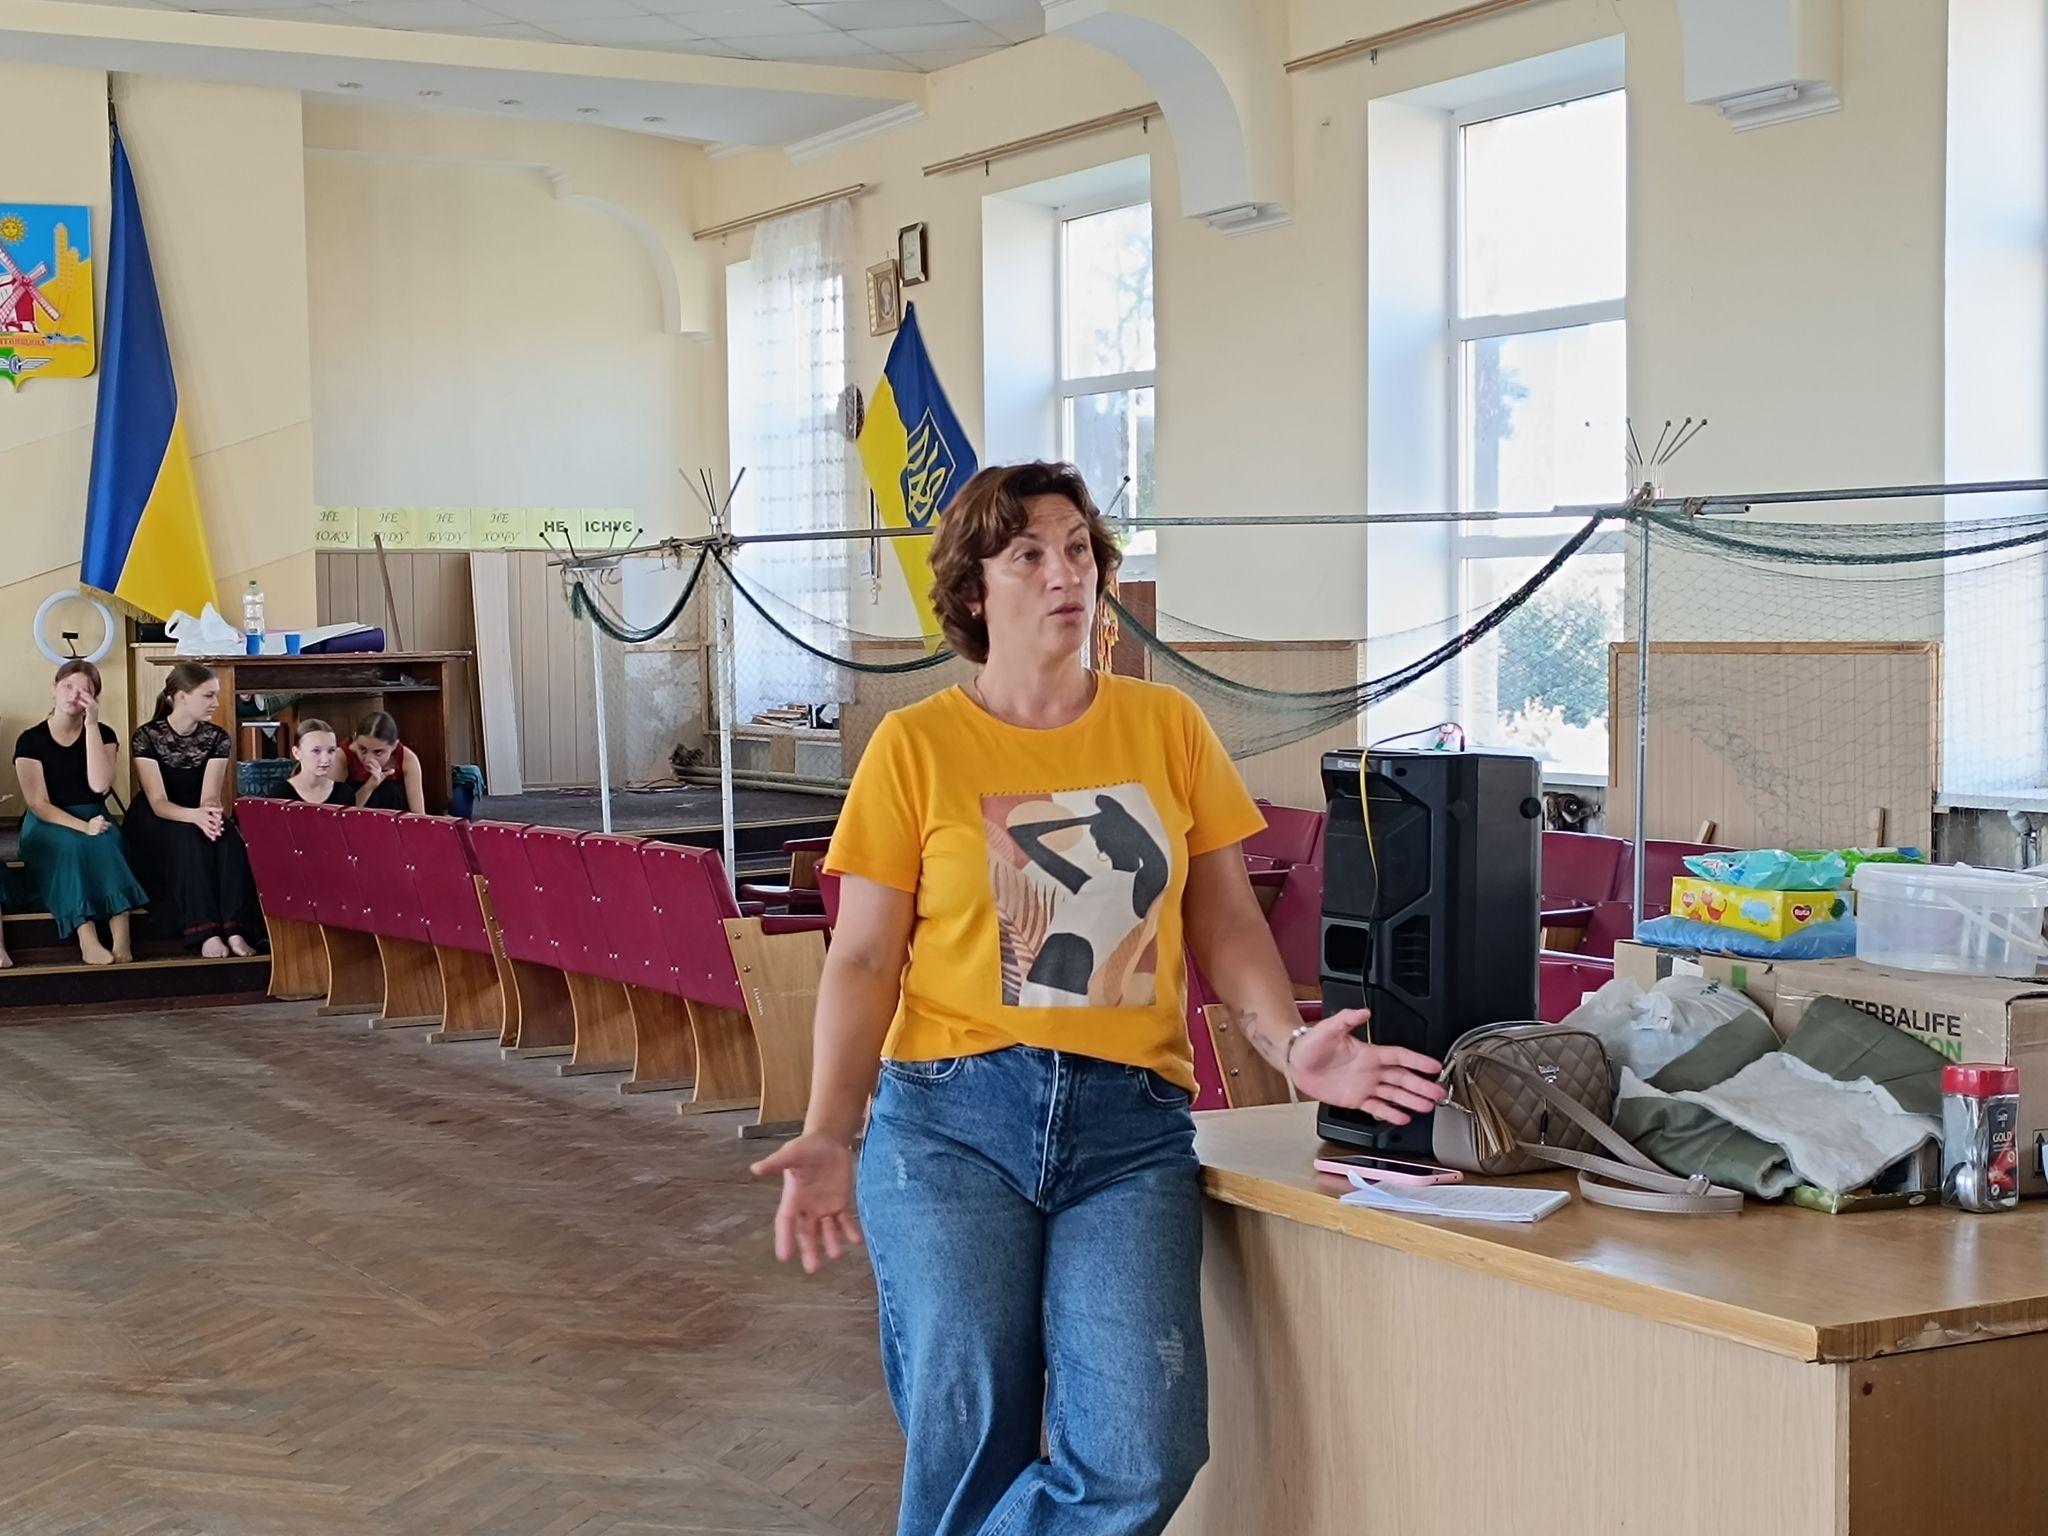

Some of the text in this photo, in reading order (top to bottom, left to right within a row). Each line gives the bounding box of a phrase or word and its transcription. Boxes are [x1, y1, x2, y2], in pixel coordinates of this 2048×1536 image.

[320, 511, 339, 521] НЕ
[379, 512, 399, 523] НЕ
[435, 513, 455, 523] НЕ
[490, 512, 510, 523] НЕ
[544, 521, 632, 532] НЕ ІСНУЄ
[481, 531, 521, 544] ХОЧУ
[1844, 999, 1961, 1037] ERBALIFE
[1992, 1131, 2013, 1143] GOLD
